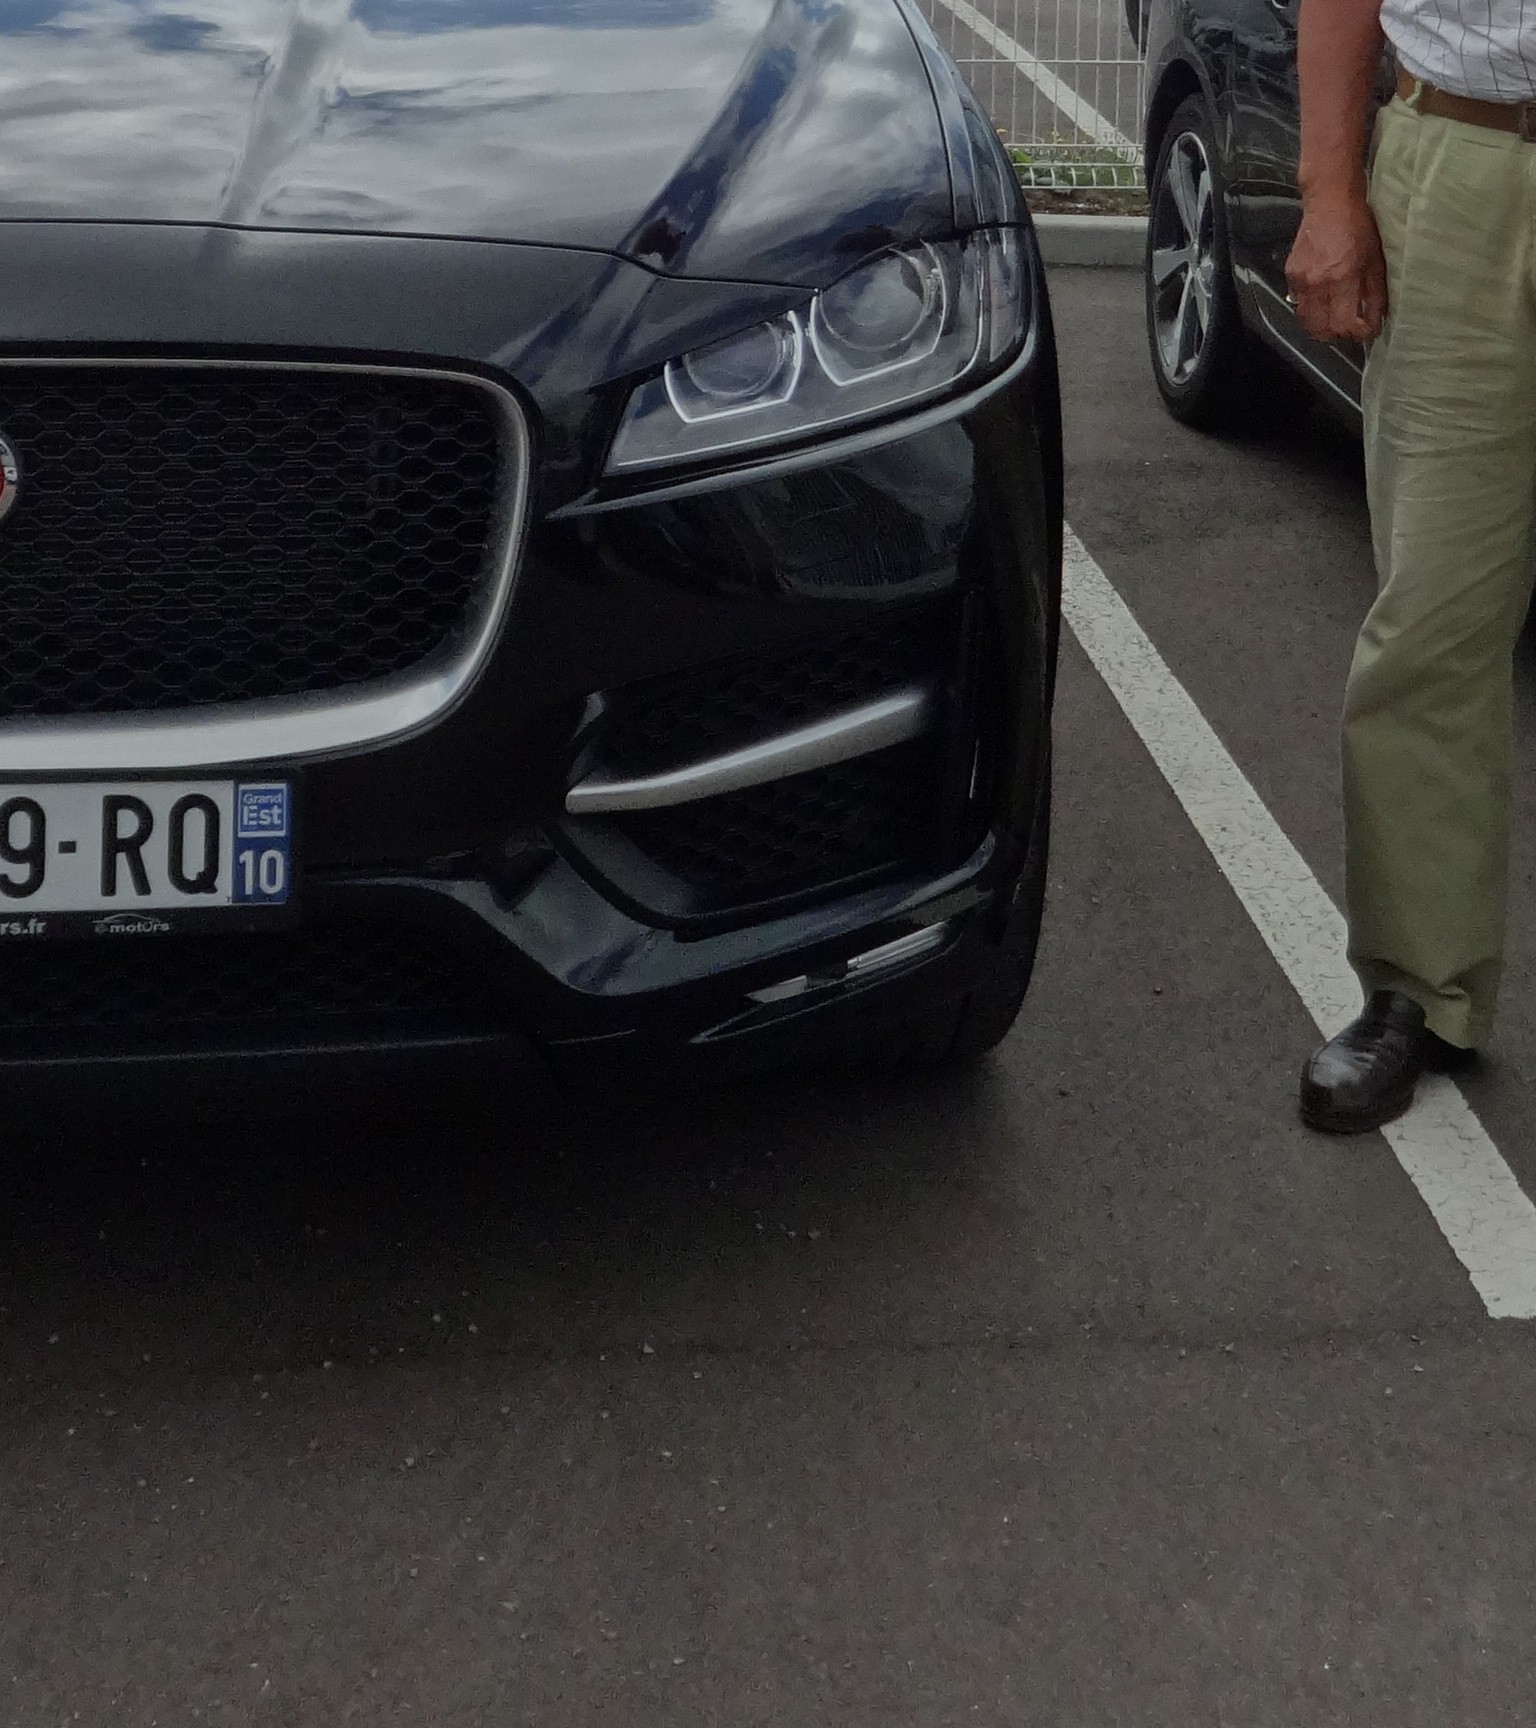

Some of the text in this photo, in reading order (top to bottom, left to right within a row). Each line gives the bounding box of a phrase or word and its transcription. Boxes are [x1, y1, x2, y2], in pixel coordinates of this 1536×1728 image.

[243, 793, 282, 804] Grand
[243, 805, 282, 825] Est
[239, 849, 284, 895] 10
